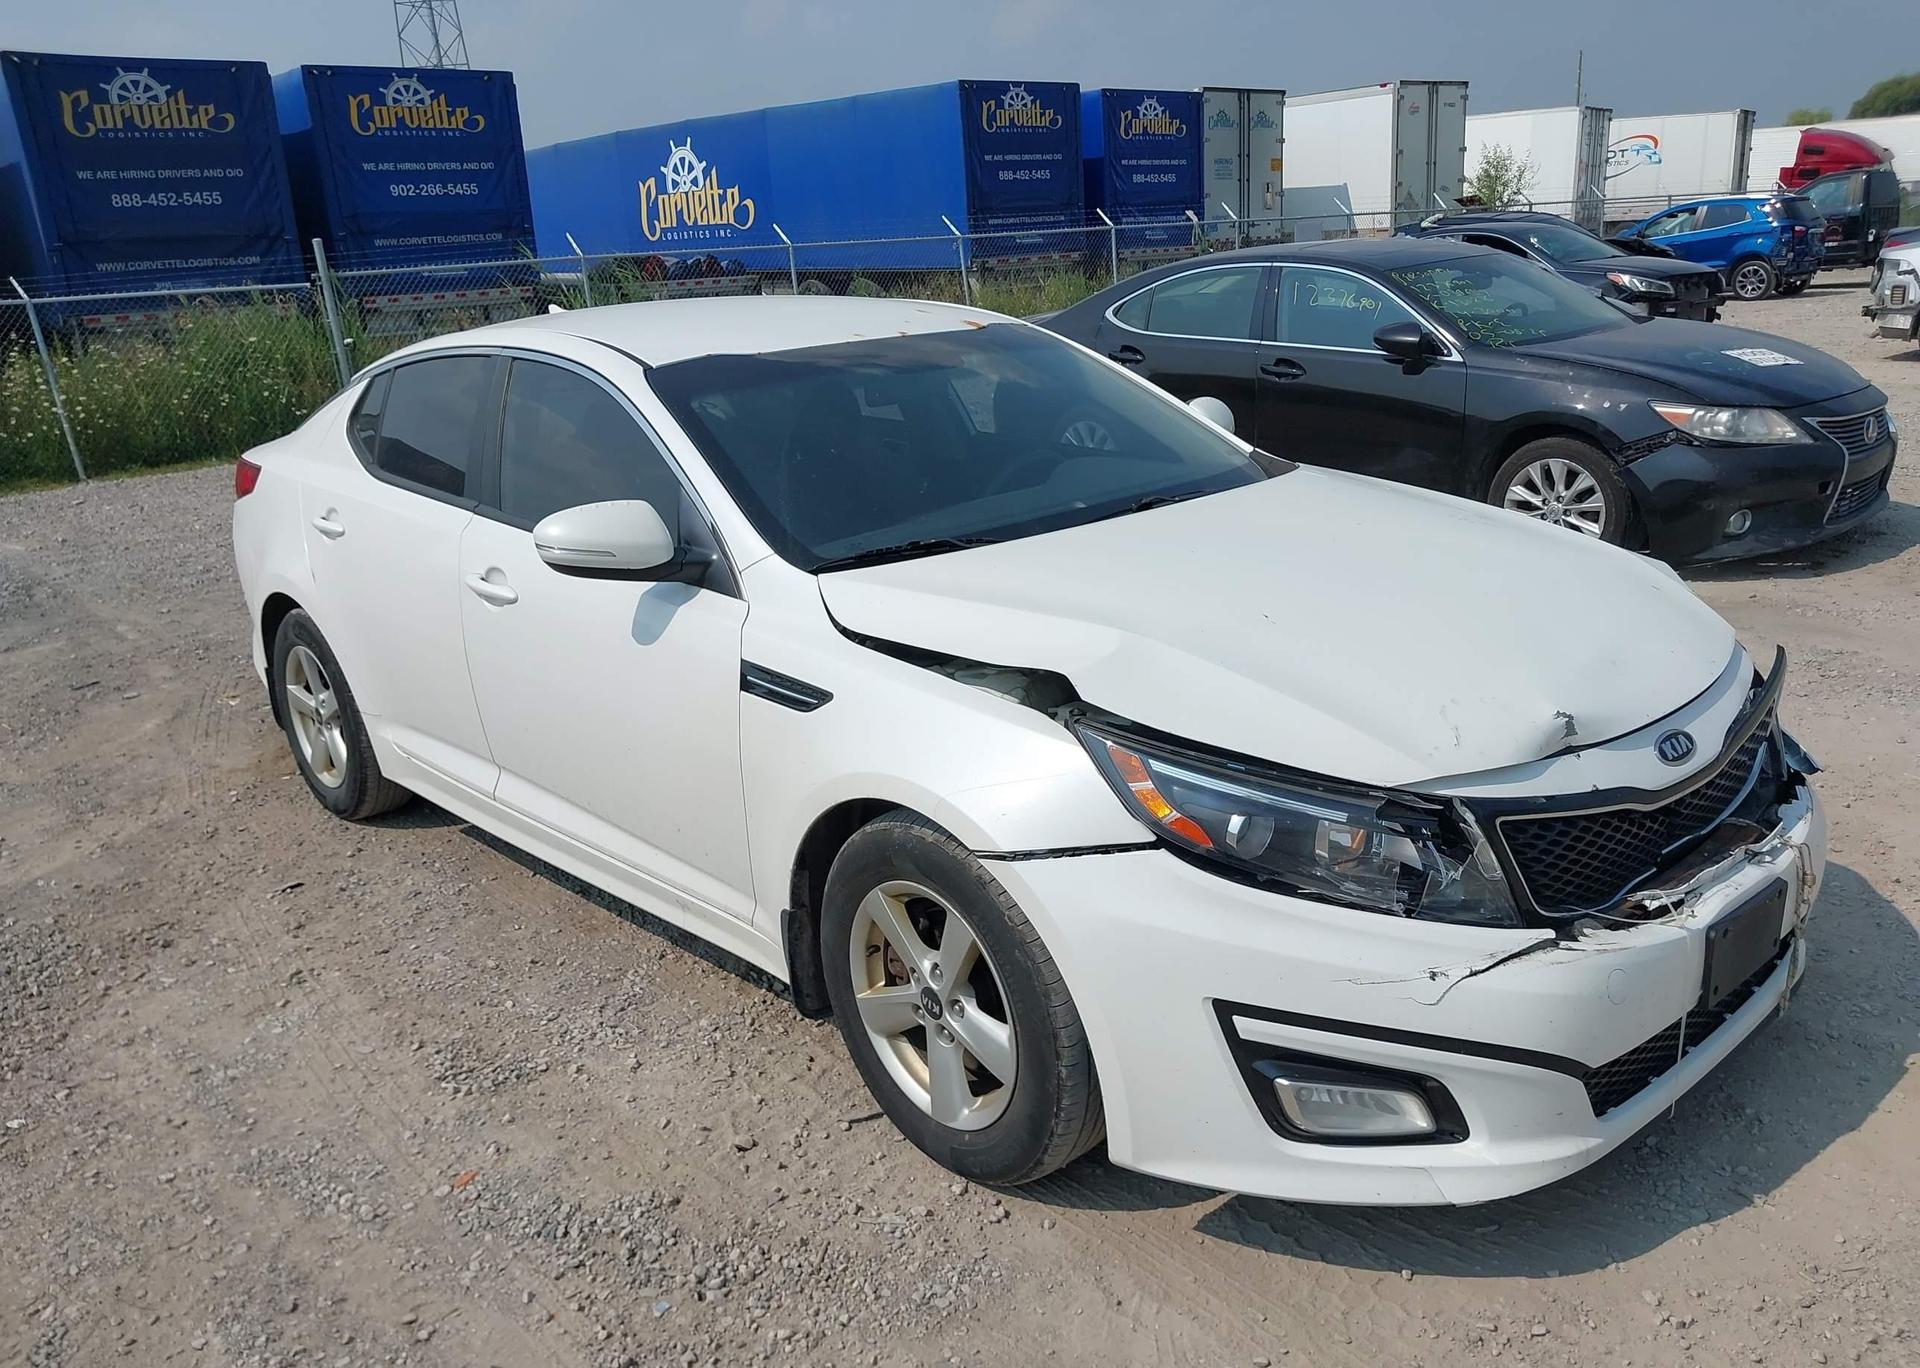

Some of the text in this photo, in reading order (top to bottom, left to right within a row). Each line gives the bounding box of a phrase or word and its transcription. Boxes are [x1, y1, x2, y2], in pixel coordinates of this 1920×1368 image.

[59, 89, 236, 138] Corvette
[348, 93, 485, 136] Corvette
[982, 98, 1062, 133] Corvette
[1120, 109, 1187, 140] Corvette
[76, 168, 243, 179] WE ARE HIRING DRIVERS AND O/O
[362, 162, 377, 171] WE
[378, 162, 396, 171] ARE
[397, 162, 426, 170] HIRING
[427, 162, 461, 170] DRIVERS
[462, 162, 479, 170] AND
[999, 169, 1051, 180] 888-452-5455
[390, 183, 479, 196] 902-266-5455
[111, 191, 223, 208] 888-452-5455
[638, 165, 755, 242] Corvette
[661, 230, 710, 241] LOGISTICS
[96, 256, 261, 272] WWW.CORVETTELOGISTICS.COM
[1660, 734, 1693, 761] KIA
